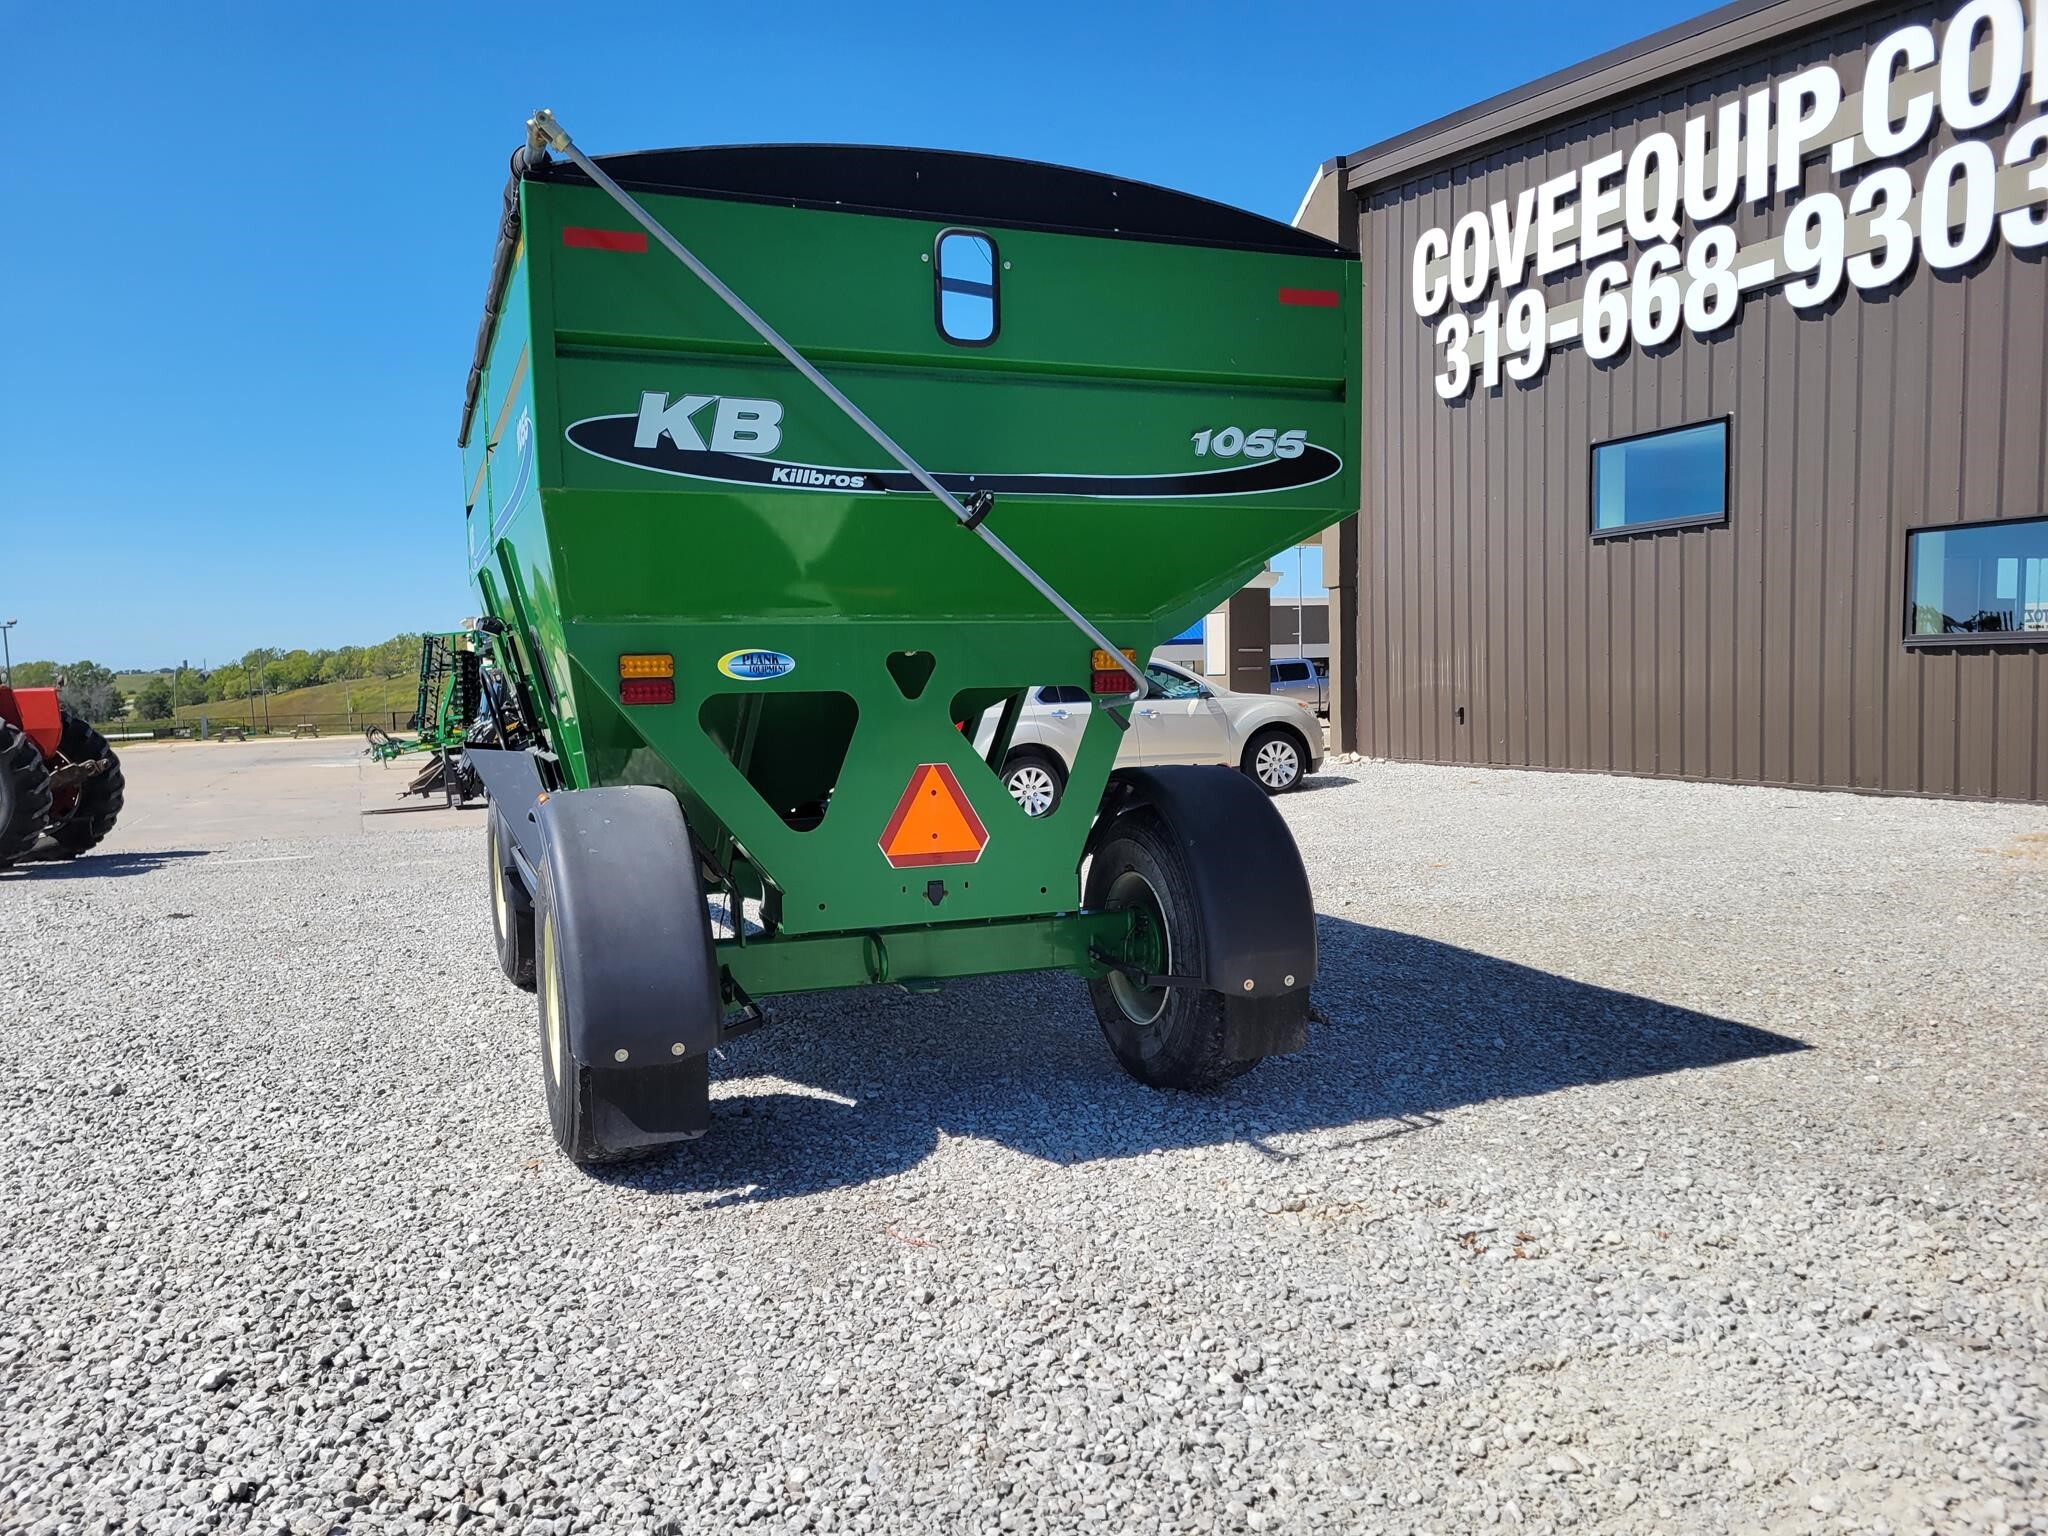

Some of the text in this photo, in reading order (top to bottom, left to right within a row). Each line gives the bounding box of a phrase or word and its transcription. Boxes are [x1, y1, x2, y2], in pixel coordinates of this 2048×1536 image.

[1412, 0, 2048, 317] COVEEQUIP.CO
[633, 390, 784, 455] KB
[1191, 426, 1308, 459] 1055
[771, 467, 866, 489] Killbros
[742, 654, 780, 665] PLANK
[749, 665, 786, 673] EQUIPMENT
